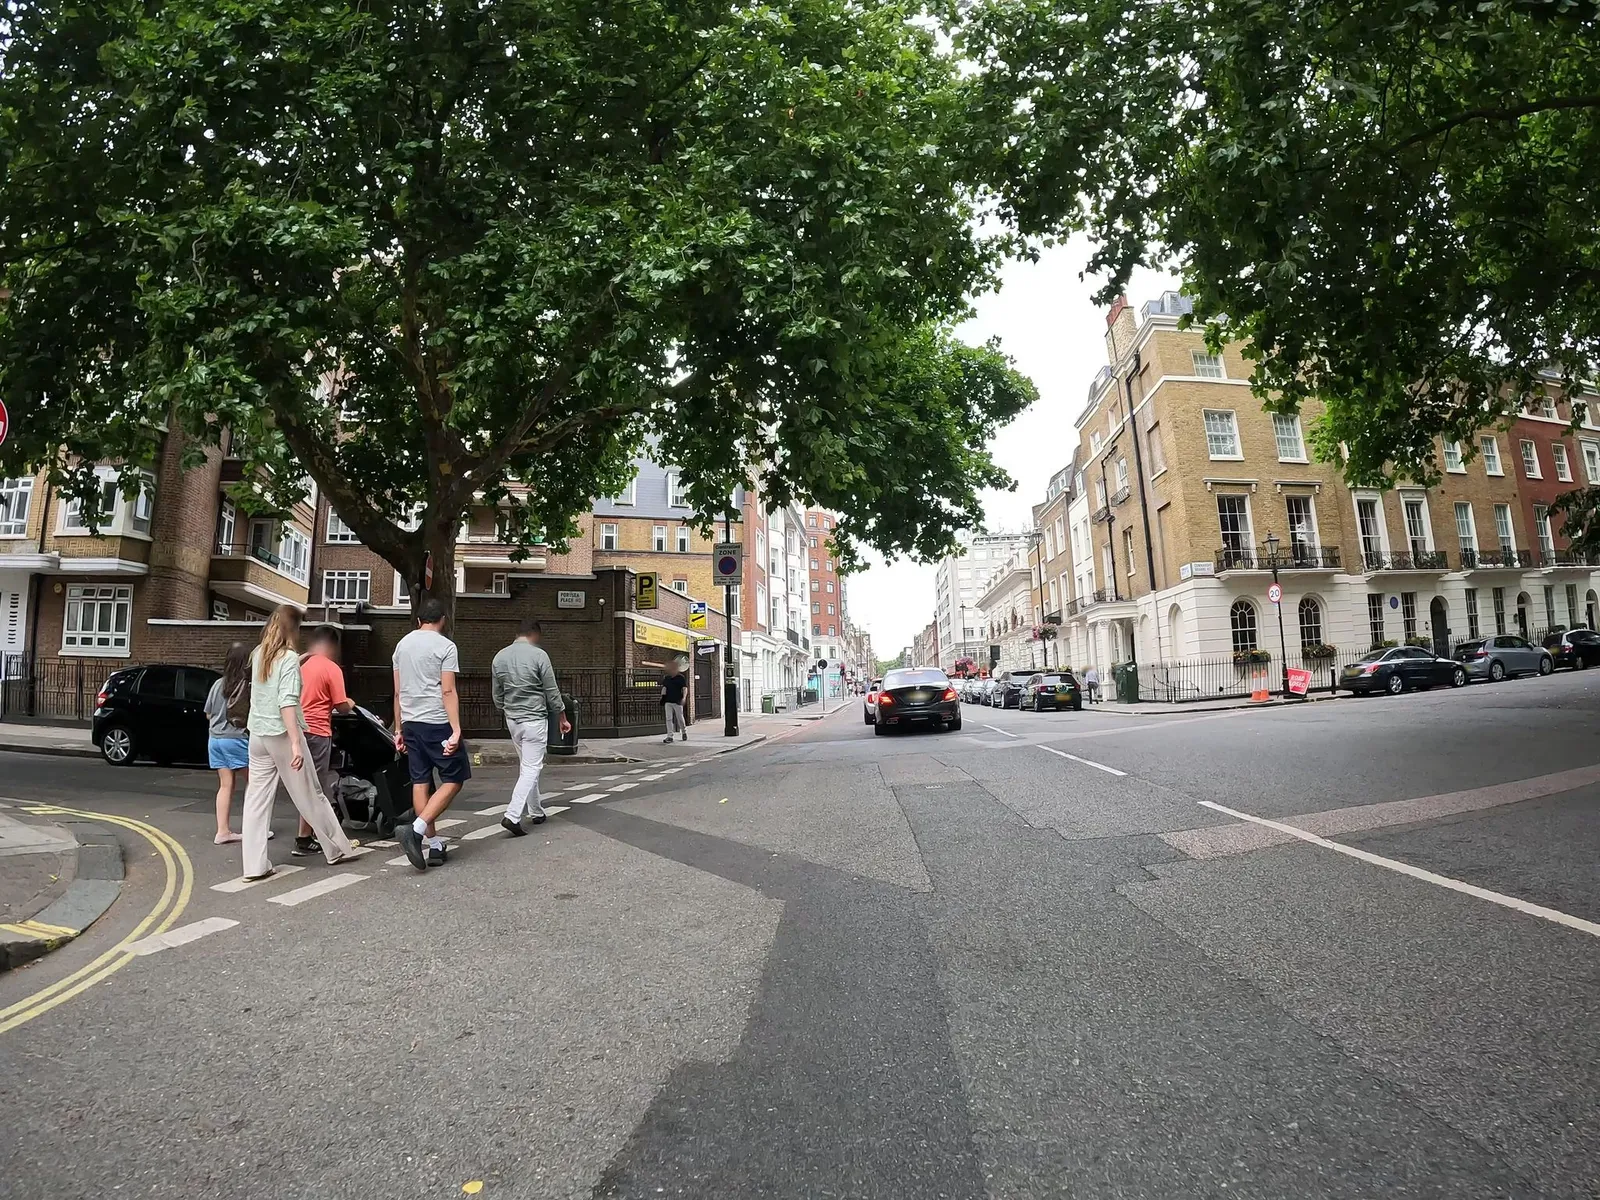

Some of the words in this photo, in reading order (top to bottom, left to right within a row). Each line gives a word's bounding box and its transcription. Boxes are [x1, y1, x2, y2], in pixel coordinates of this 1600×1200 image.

[639, 576, 653, 595] P
[1270, 589, 1280, 598] 20
[690, 603, 699, 614] P
[1290, 674, 1306, 682] ROAD
